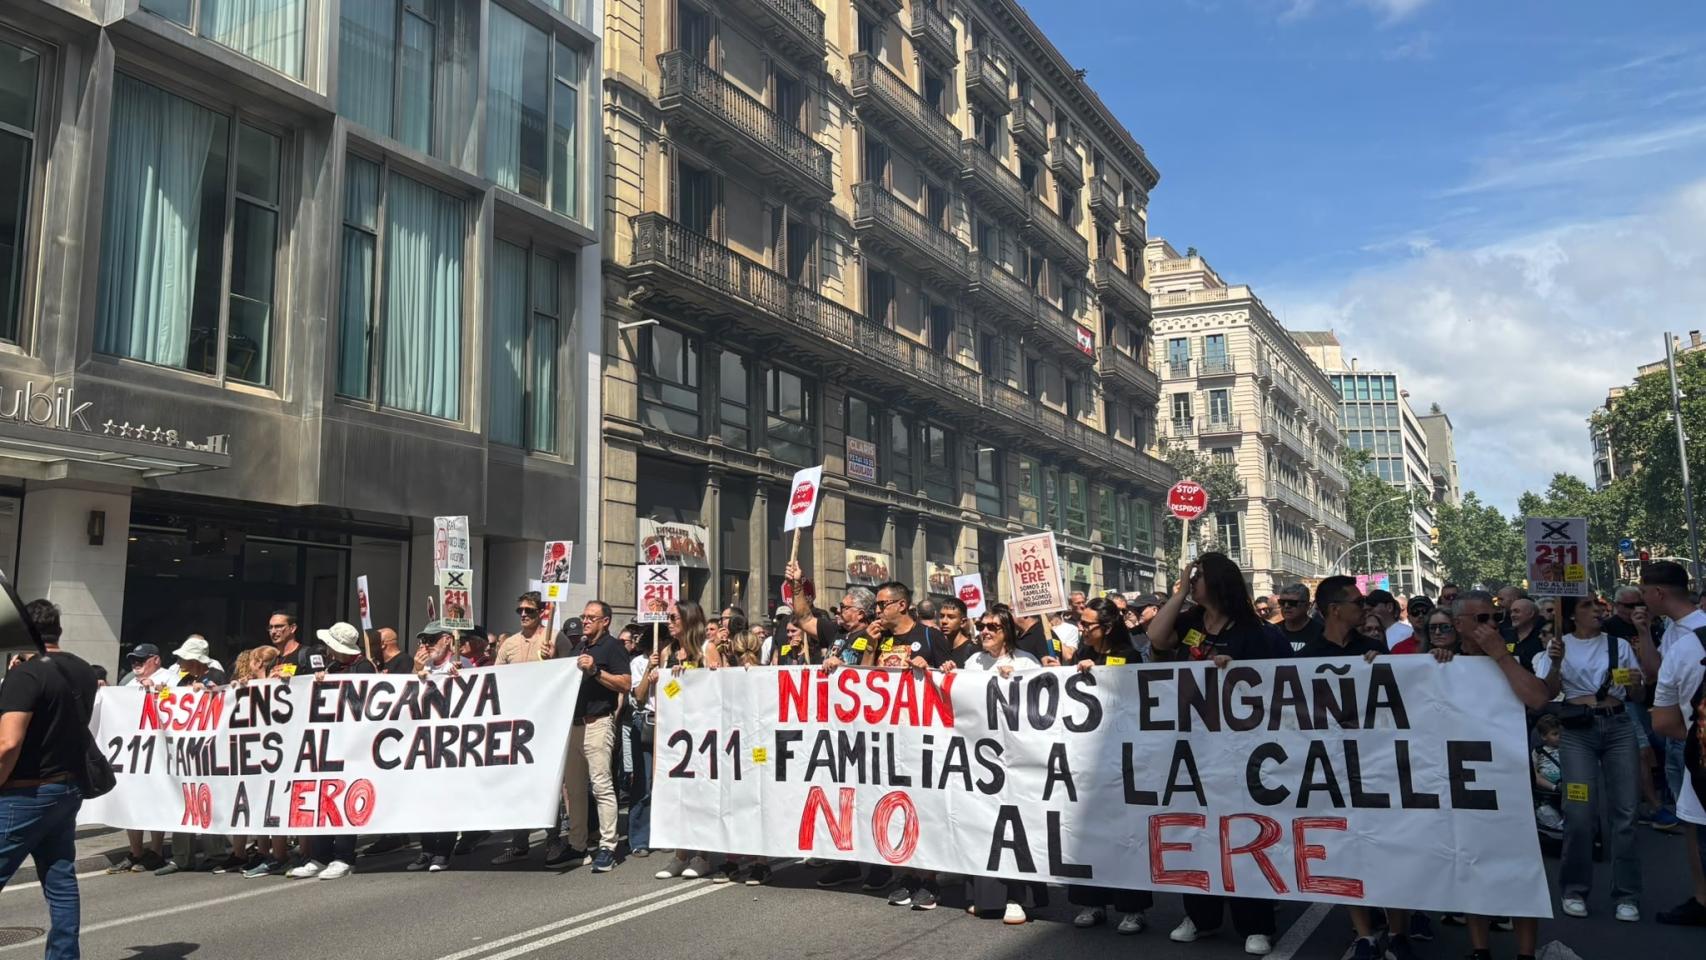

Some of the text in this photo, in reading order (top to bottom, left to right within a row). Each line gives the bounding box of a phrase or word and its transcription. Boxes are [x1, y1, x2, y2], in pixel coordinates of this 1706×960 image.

[1176, 485, 1199, 494] STOP
[1171, 504, 1202, 513] DESPIDOS
[1535, 544, 1578, 565] 211
[1014, 558, 1050, 574] NO AL
[1020, 570, 1046, 584] ERE
[644, 584, 673, 600] 211
[1019, 581, 1050, 592] SOMOS 211
[445, 590, 469, 606] 211
[1031, 593, 1052, 601] SOMOS
[229, 684, 294, 728] ENS
[309, 673, 501, 723] ENGANYA
[986, 671, 1103, 733] NOS
[1137, 663, 1411, 732] ENGAÑA
[108, 735, 156, 774] 211
[294, 729, 344, 773] AL
[372, 719, 535, 770] CARRER
[667, 729, 742, 781] 211
[1042, 742, 1078, 802] A
[1121, 740, 1208, 806] LA
[1246, 740, 1499, 810] CALLE
[181, 778, 377, 829] NO A L'ERO
[797, 786, 1364, 898] NO AL ERE
